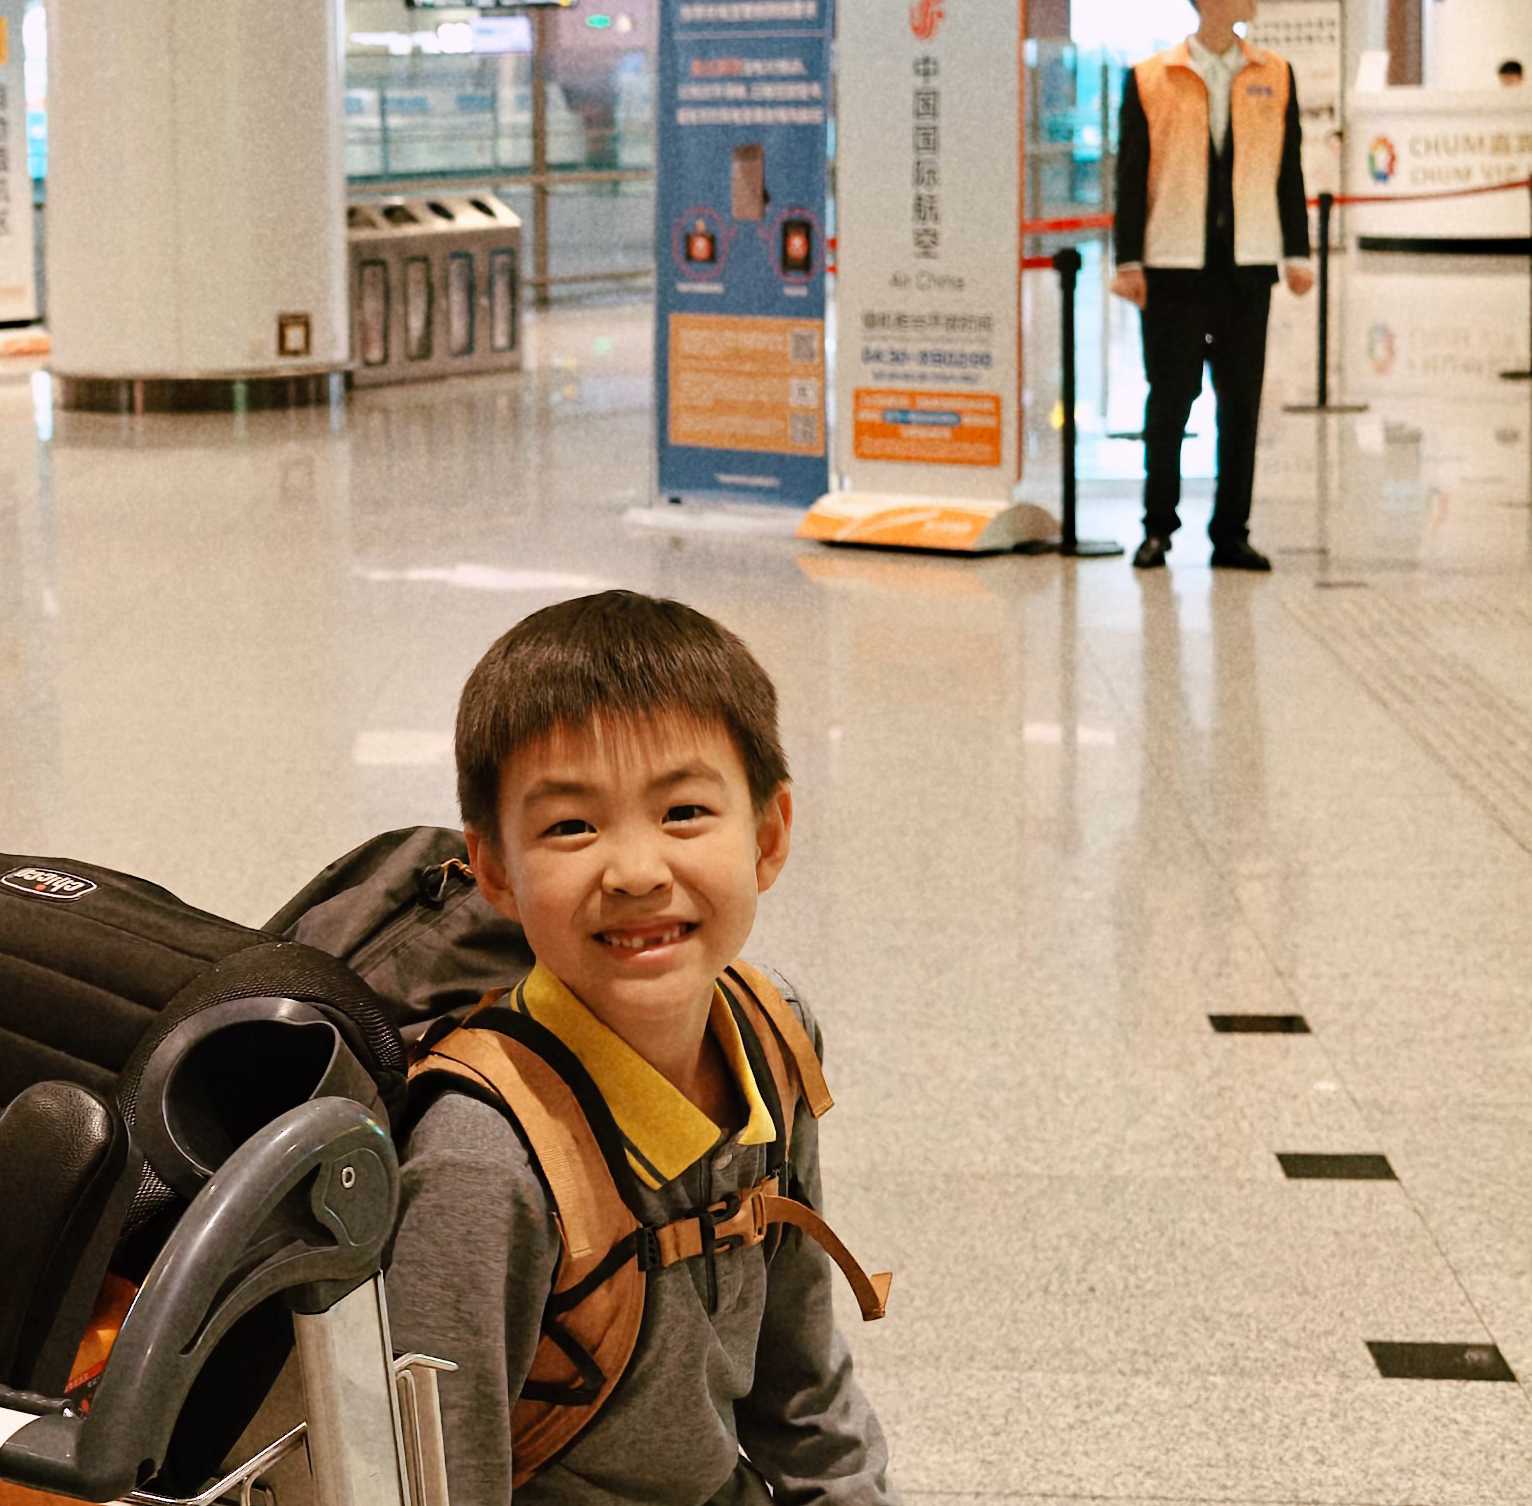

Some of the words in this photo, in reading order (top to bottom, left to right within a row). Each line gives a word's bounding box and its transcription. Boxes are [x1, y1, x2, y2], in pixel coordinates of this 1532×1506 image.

[911, 56, 941, 261] 中国国际航空
